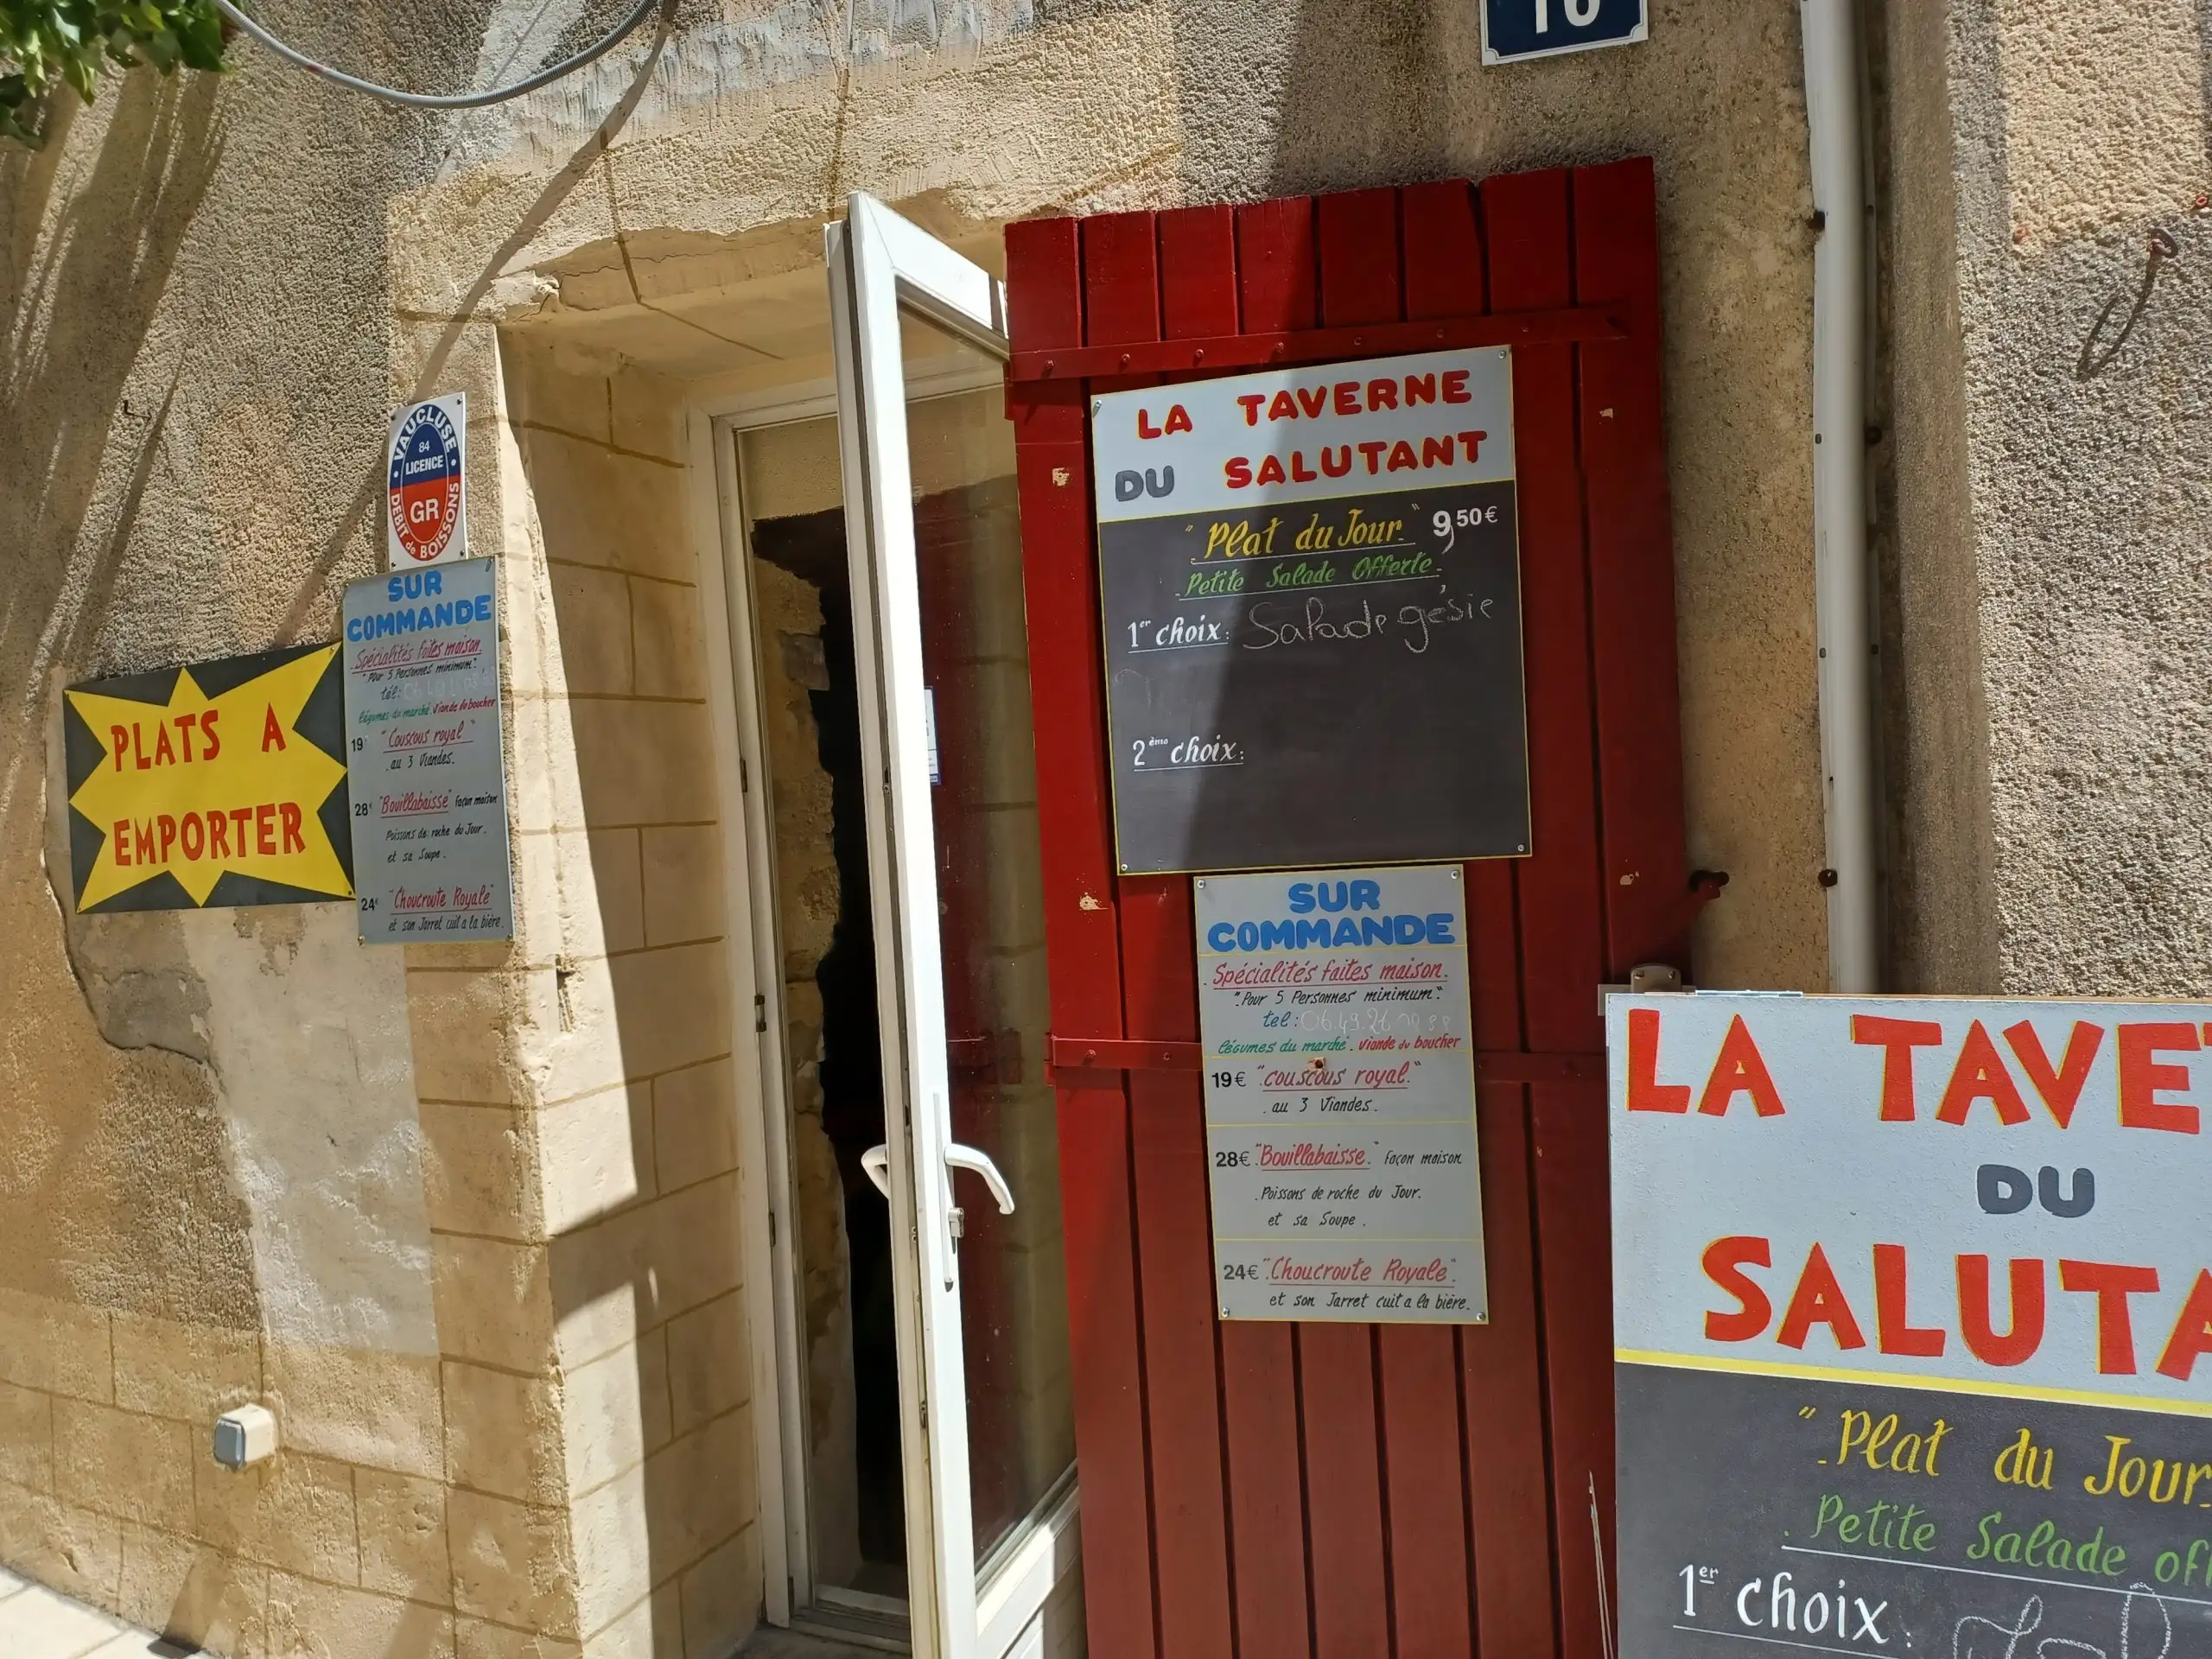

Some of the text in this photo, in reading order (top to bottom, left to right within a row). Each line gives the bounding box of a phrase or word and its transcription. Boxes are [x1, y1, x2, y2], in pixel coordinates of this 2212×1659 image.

[1138, 370, 1472, 439] LA TAVERNE
[394, 406, 456, 461] VAUCLUSE
[418, 441, 430, 453] 84
[406, 455, 443, 475] LICENCE
[1115, 430, 1488, 501] DU SALUTANT
[391, 482, 459, 559] DEBIT de BOISSONS
[410, 498, 439, 524] GR
[1296, 513, 1331, 550] du
[388, 570, 442, 601] SUR
[1185, 569, 1244, 596] Petite
[1267, 556, 1336, 588] Salade
[347, 594, 491, 642] COMMANDE
[387, 670, 393, 680] 5
[467, 696, 496, 710] boucher
[111, 702, 287, 772] PLATS A
[390, 759, 402, 770] au
[408, 755, 413, 768] 3
[474, 791, 499, 805] maison
[114, 802, 306, 866] EMPORTER
[417, 827, 427, 838] de
[431, 824, 450, 837] roche
[454, 823, 464, 835] du
[388, 851, 396, 862] et
[402, 851, 412, 861] sa
[1288, 880, 1381, 913] SUR
[389, 918, 396, 931] et
[402, 922, 415, 932] son
[418, 916, 442, 931] Jarret
[446, 914, 460, 929] cuit
[461, 919, 467, 929] a
[469, 916, 478, 929] la
[1207, 913, 1455, 952] COMMANDE
[1213, 958, 1318, 987] Spécialités
[1275, 991, 1284, 1005] 5
[1291, 990, 1357, 1005] Personnes
[1280, 1039, 1296, 1053] du
[1398, 1039, 1410, 1049] du
[1414, 1033, 1462, 1050] boucher
[1211, 1071, 1247, 1088] 19€
[1626, 1008, 2212, 1135] LA TAVE
[1272, 1101, 1288, 1113] au
[1300, 1097, 1307, 1112] 3
[1215, 1151, 1250, 1167] 28€
[1421, 1147, 1462, 1165] maison
[1261, 1185, 1306, 1201] Poissons
[1312, 1186, 1323, 1200] de
[1327, 1184, 1359, 1199] roche
[1369, 1185, 1382, 1199] du
[1976, 1164, 2095, 1218] DU
[1268, 1211, 1280, 1226] et
[1293, 1213, 1307, 1225] sa
[1224, 1264, 1259, 1281] 24€
[1269, 1291, 1286, 1306] et
[1294, 1294, 1315, 1307] son
[1325, 1291, 1369, 1308] Jarret
[1376, 1292, 1399, 1309] cuit
[1403, 1295, 1411, 1308] a
[1416, 1293, 1429, 1309] la
[1994, 1427, 2054, 1491] du
[1810, 1493, 2212, 1586] Petite Salade of
[1678, 1563, 1719, 1618] 1er
